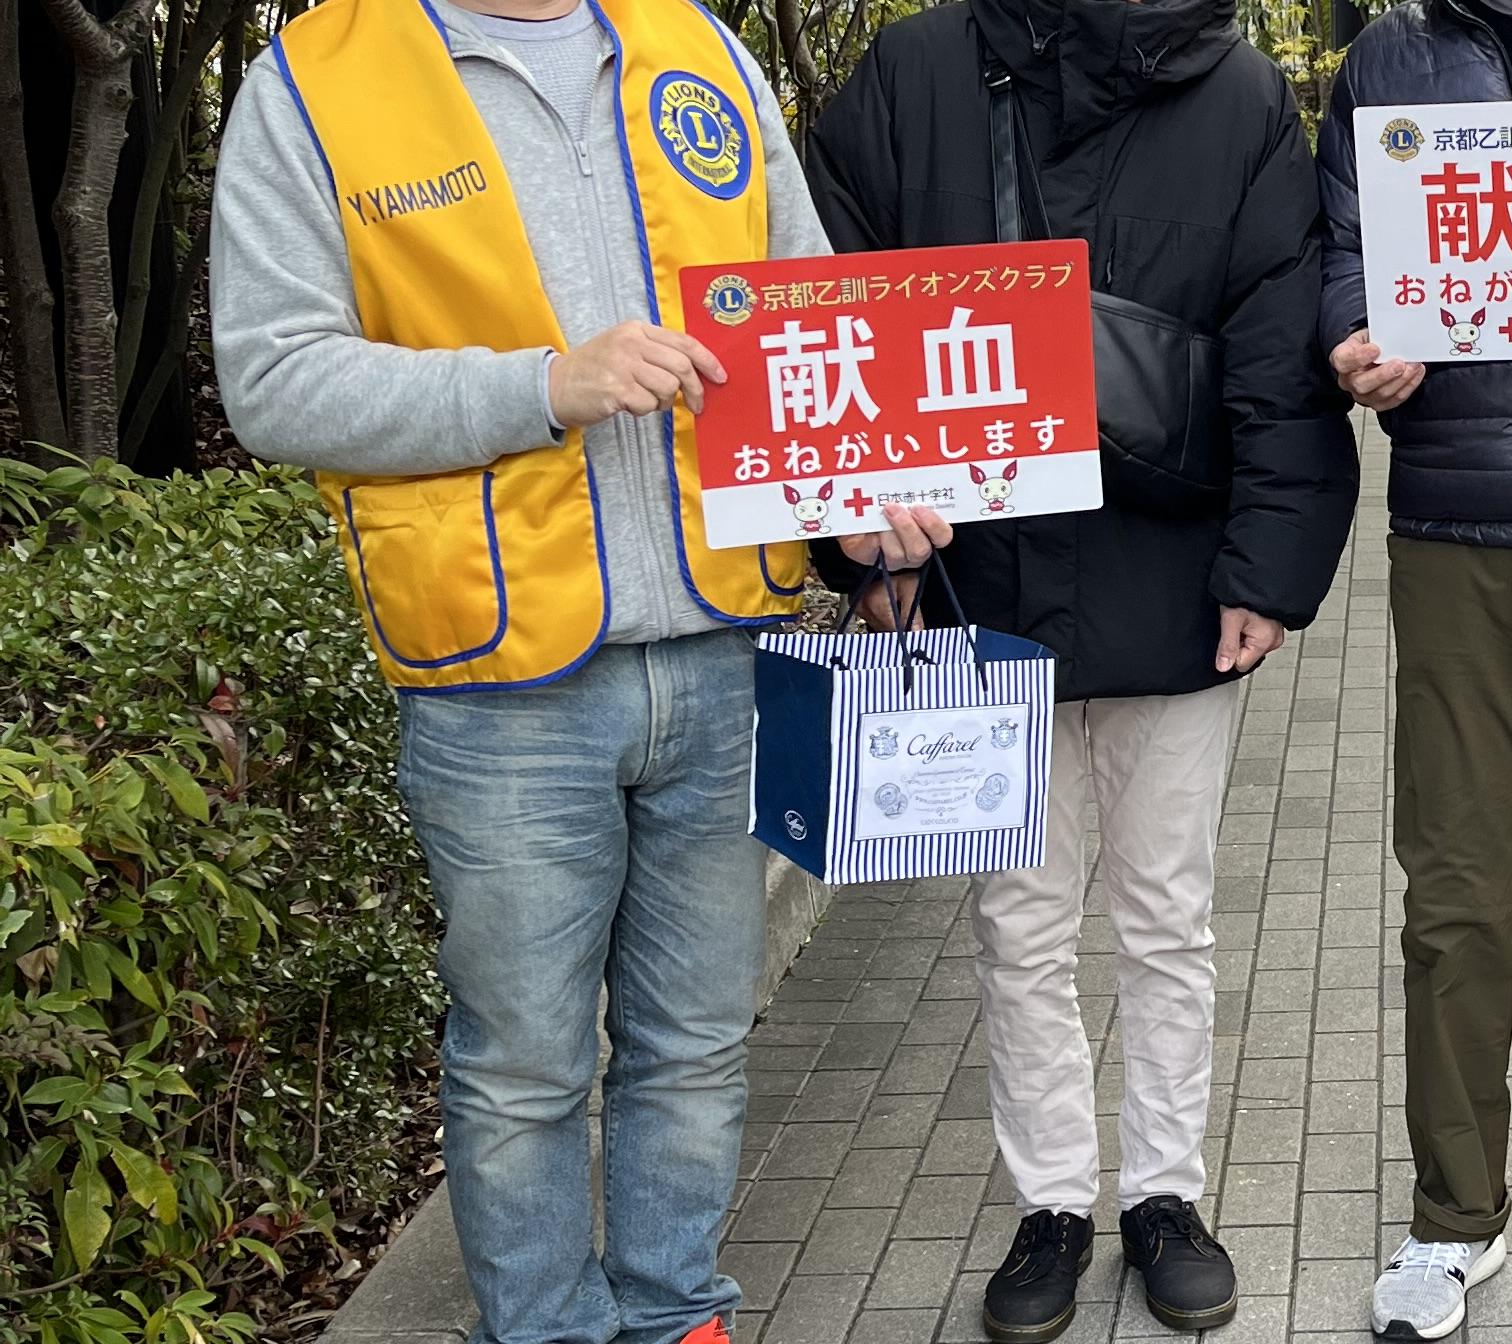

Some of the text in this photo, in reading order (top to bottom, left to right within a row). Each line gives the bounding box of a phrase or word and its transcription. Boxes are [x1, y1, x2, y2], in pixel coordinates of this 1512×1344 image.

[667, 83, 718, 109] LIONS
[687, 111, 719, 150] L
[346, 160, 487, 226] Y.YAMAMOTO
[760, 262, 1074, 312] 京都乙訓ライオンズクラブ
[759, 305, 1028, 433] 献血
[733, 413, 1065, 482] おねがいします
[907, 732, 982, 765] Caffarel
